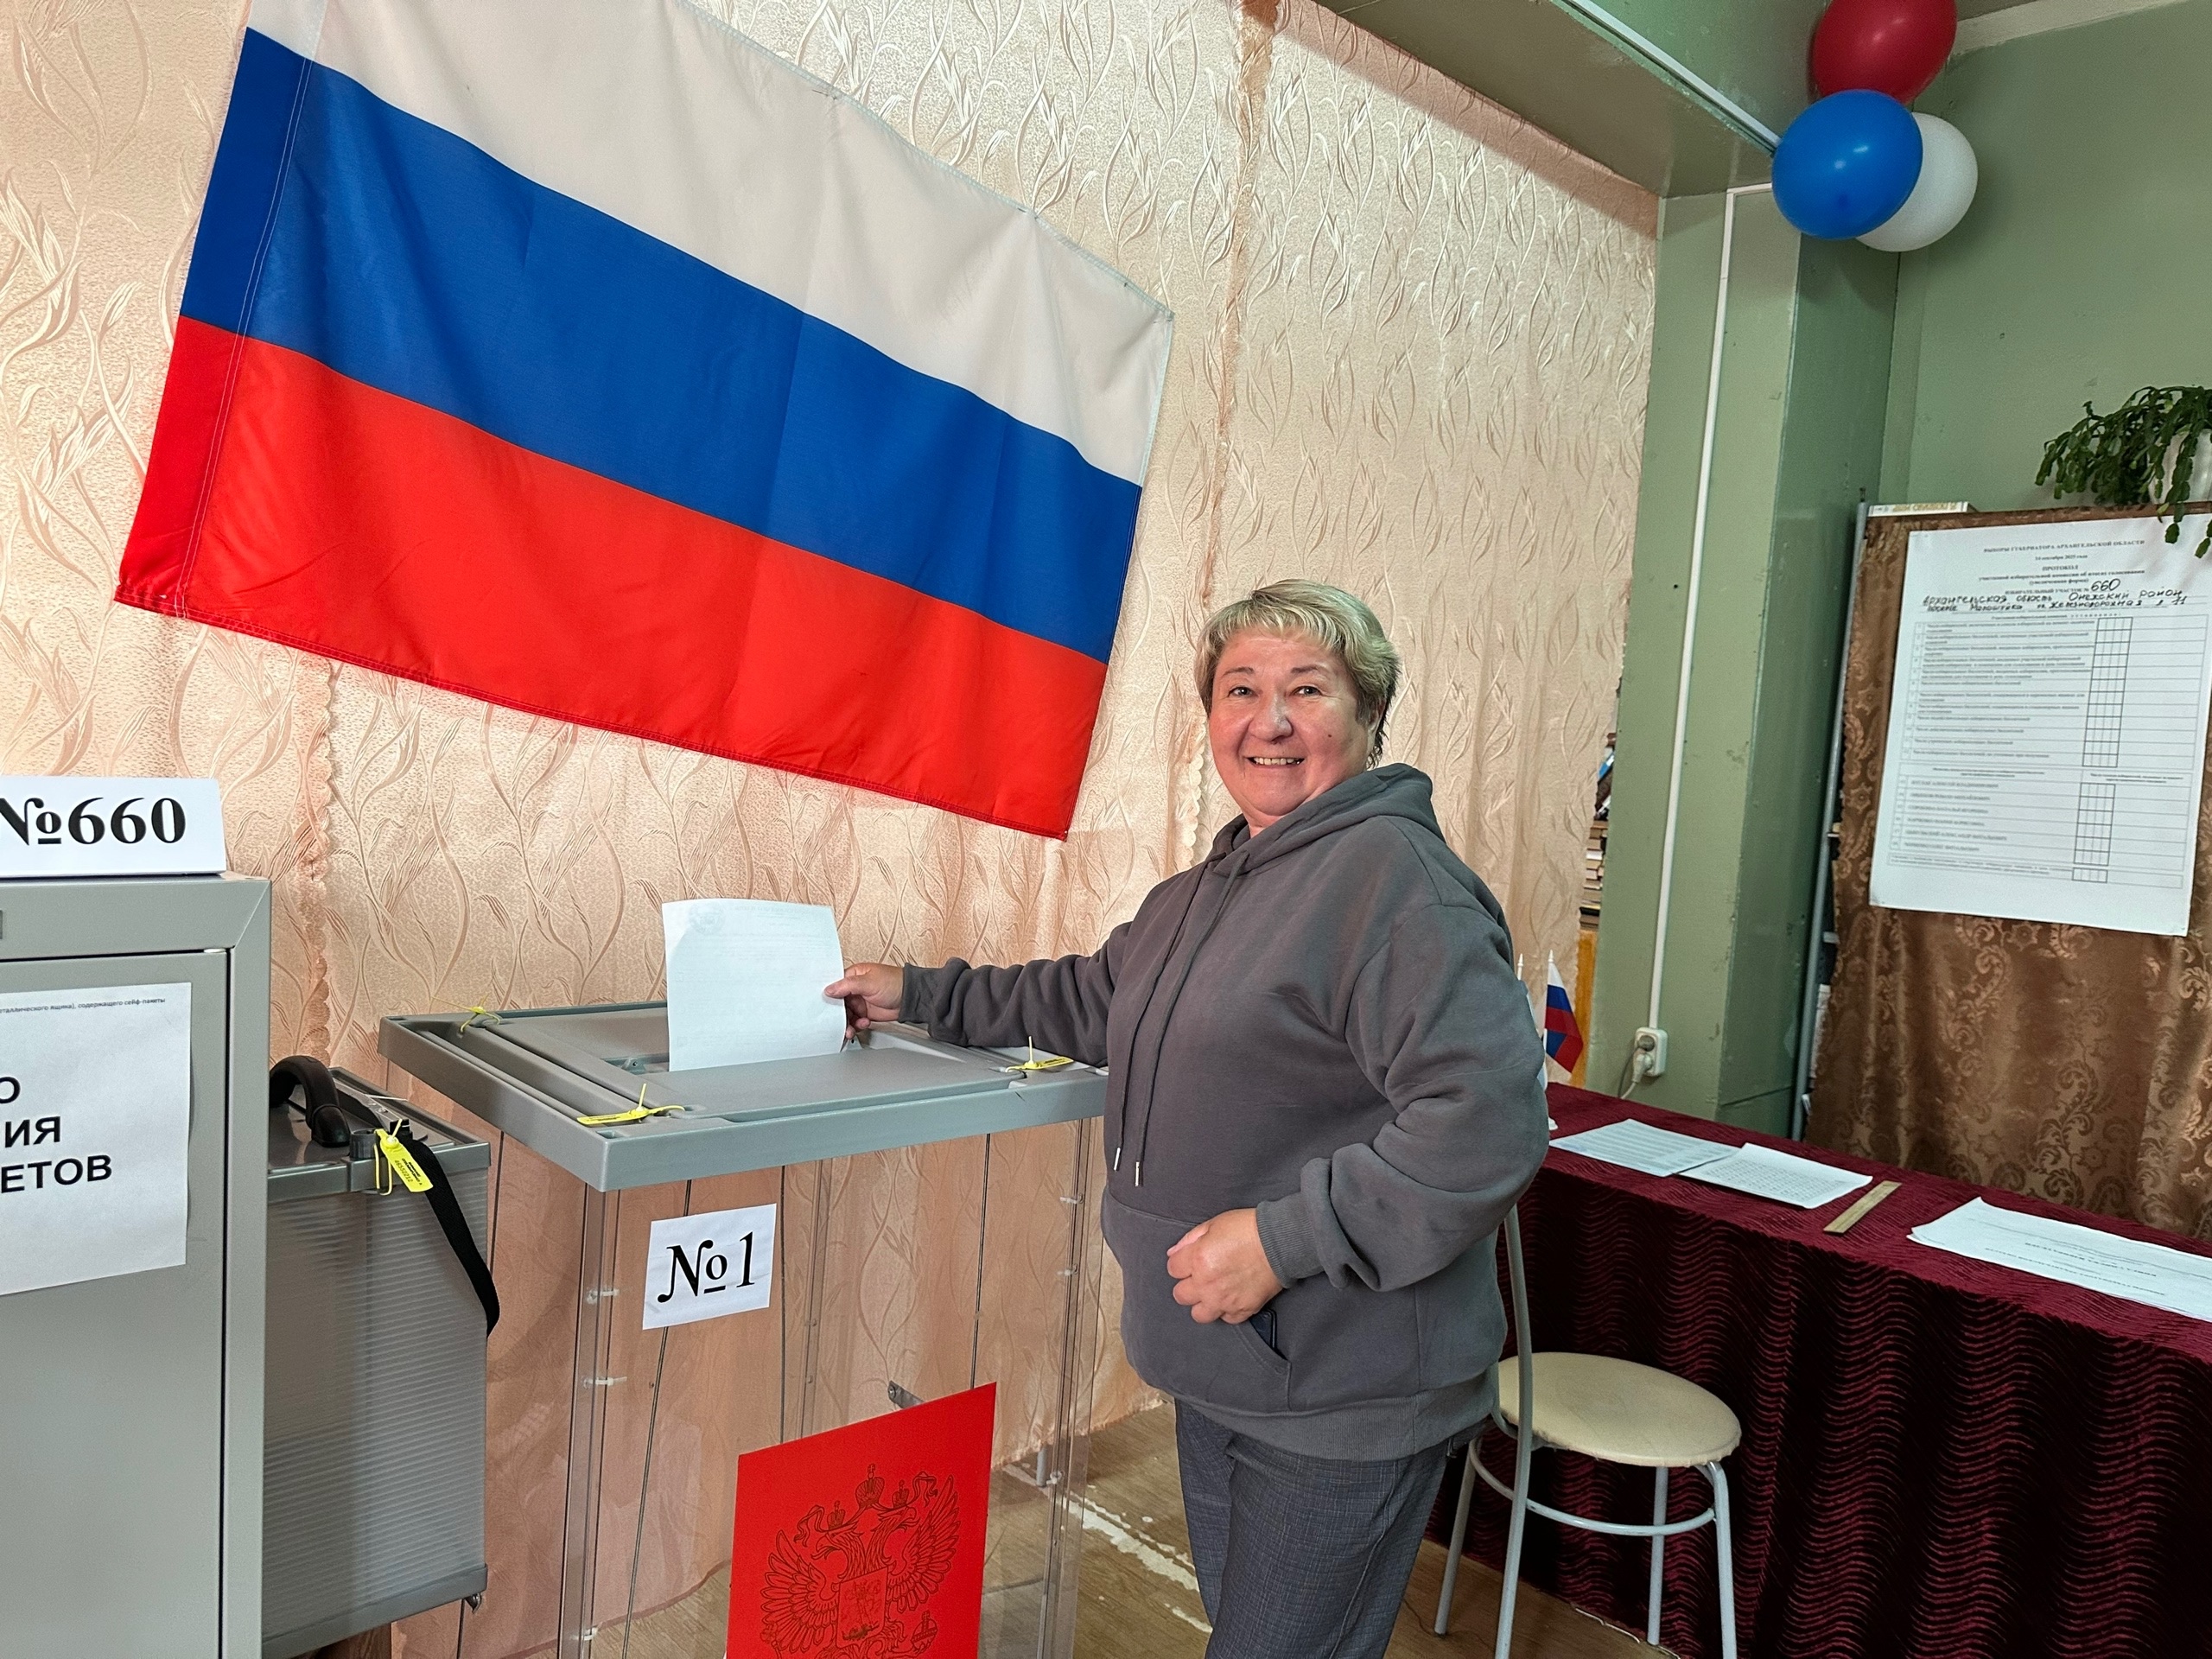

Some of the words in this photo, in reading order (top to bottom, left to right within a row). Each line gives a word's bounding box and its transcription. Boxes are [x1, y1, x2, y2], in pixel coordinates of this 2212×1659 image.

[2091, 578, 2121, 592] 660
[0, 797, 186, 846] №660
[77, 1000, 123, 1009] содержащего
[124, 997, 166, 1006] сейф-пакеты
[4, 1116, 60, 1148] ИЯ
[1, 1154, 112, 1193] ЕТОВ
[658, 1231, 755, 1303] №1
